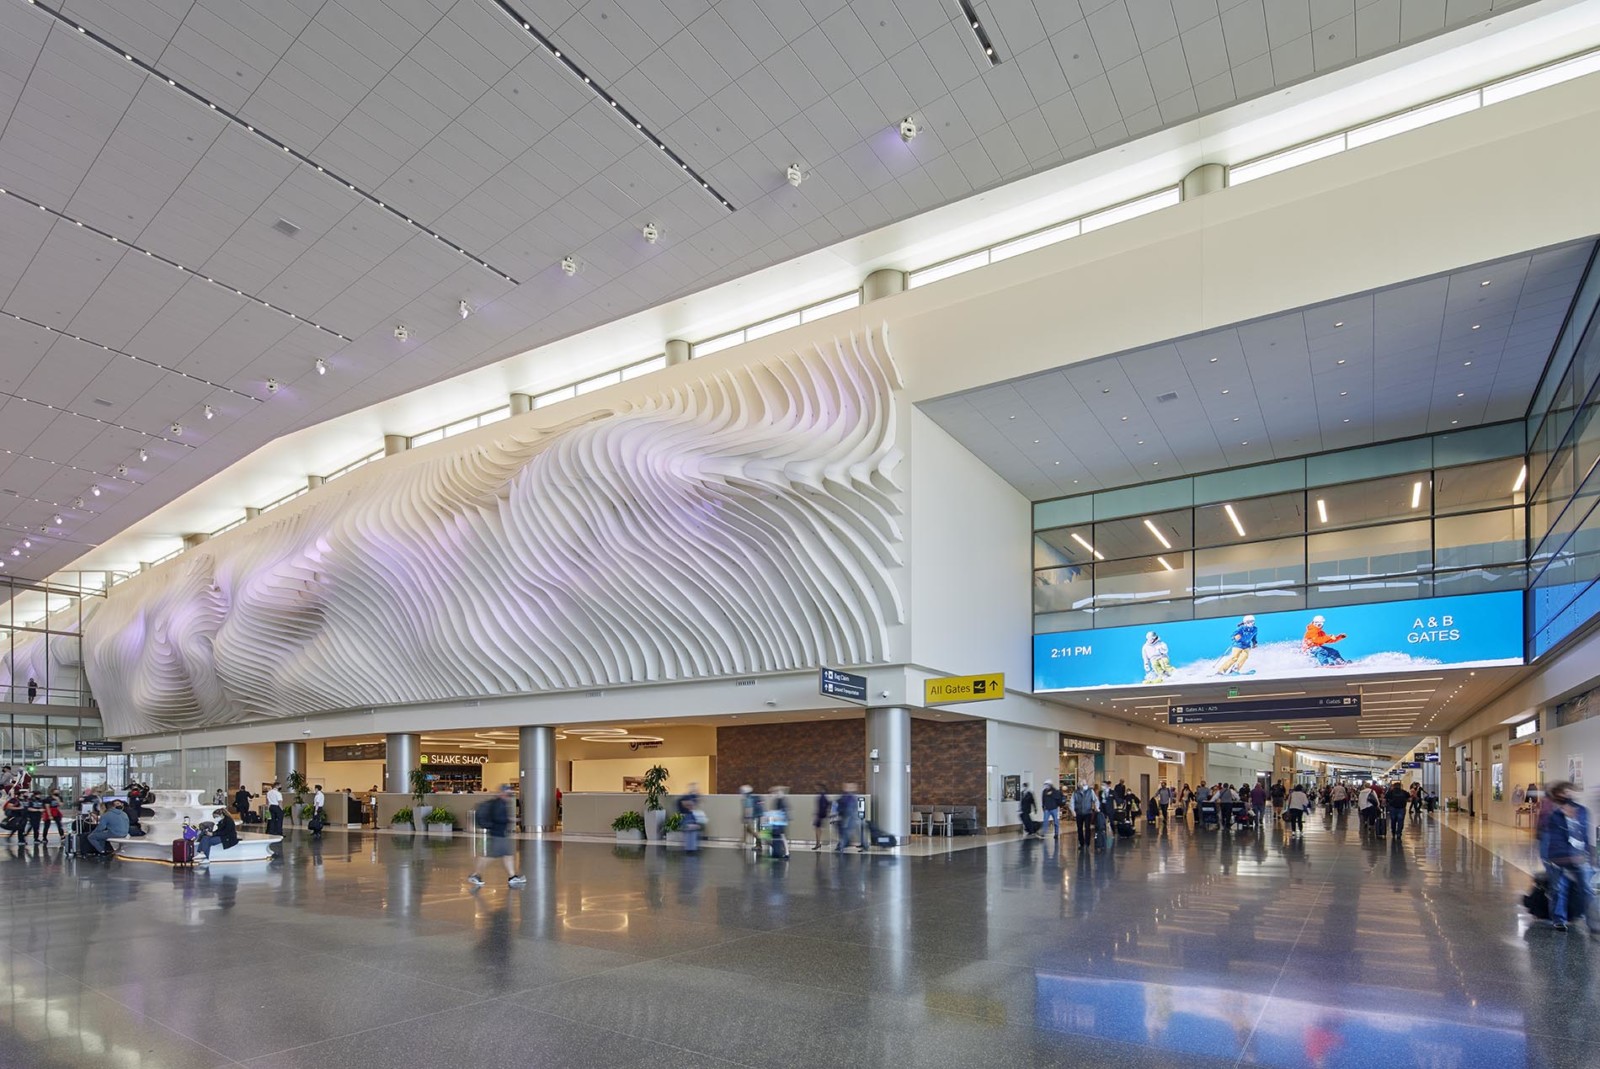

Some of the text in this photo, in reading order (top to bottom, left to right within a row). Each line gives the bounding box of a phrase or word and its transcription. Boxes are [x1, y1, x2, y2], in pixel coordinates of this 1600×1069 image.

[1413, 615, 1454, 629] A & B
[1407, 629, 1460, 643] GATES
[1051, 646, 1092, 658] 2:11 PM
[931, 684, 971, 695] All Gates
[431, 754, 461, 764] SHAKE
